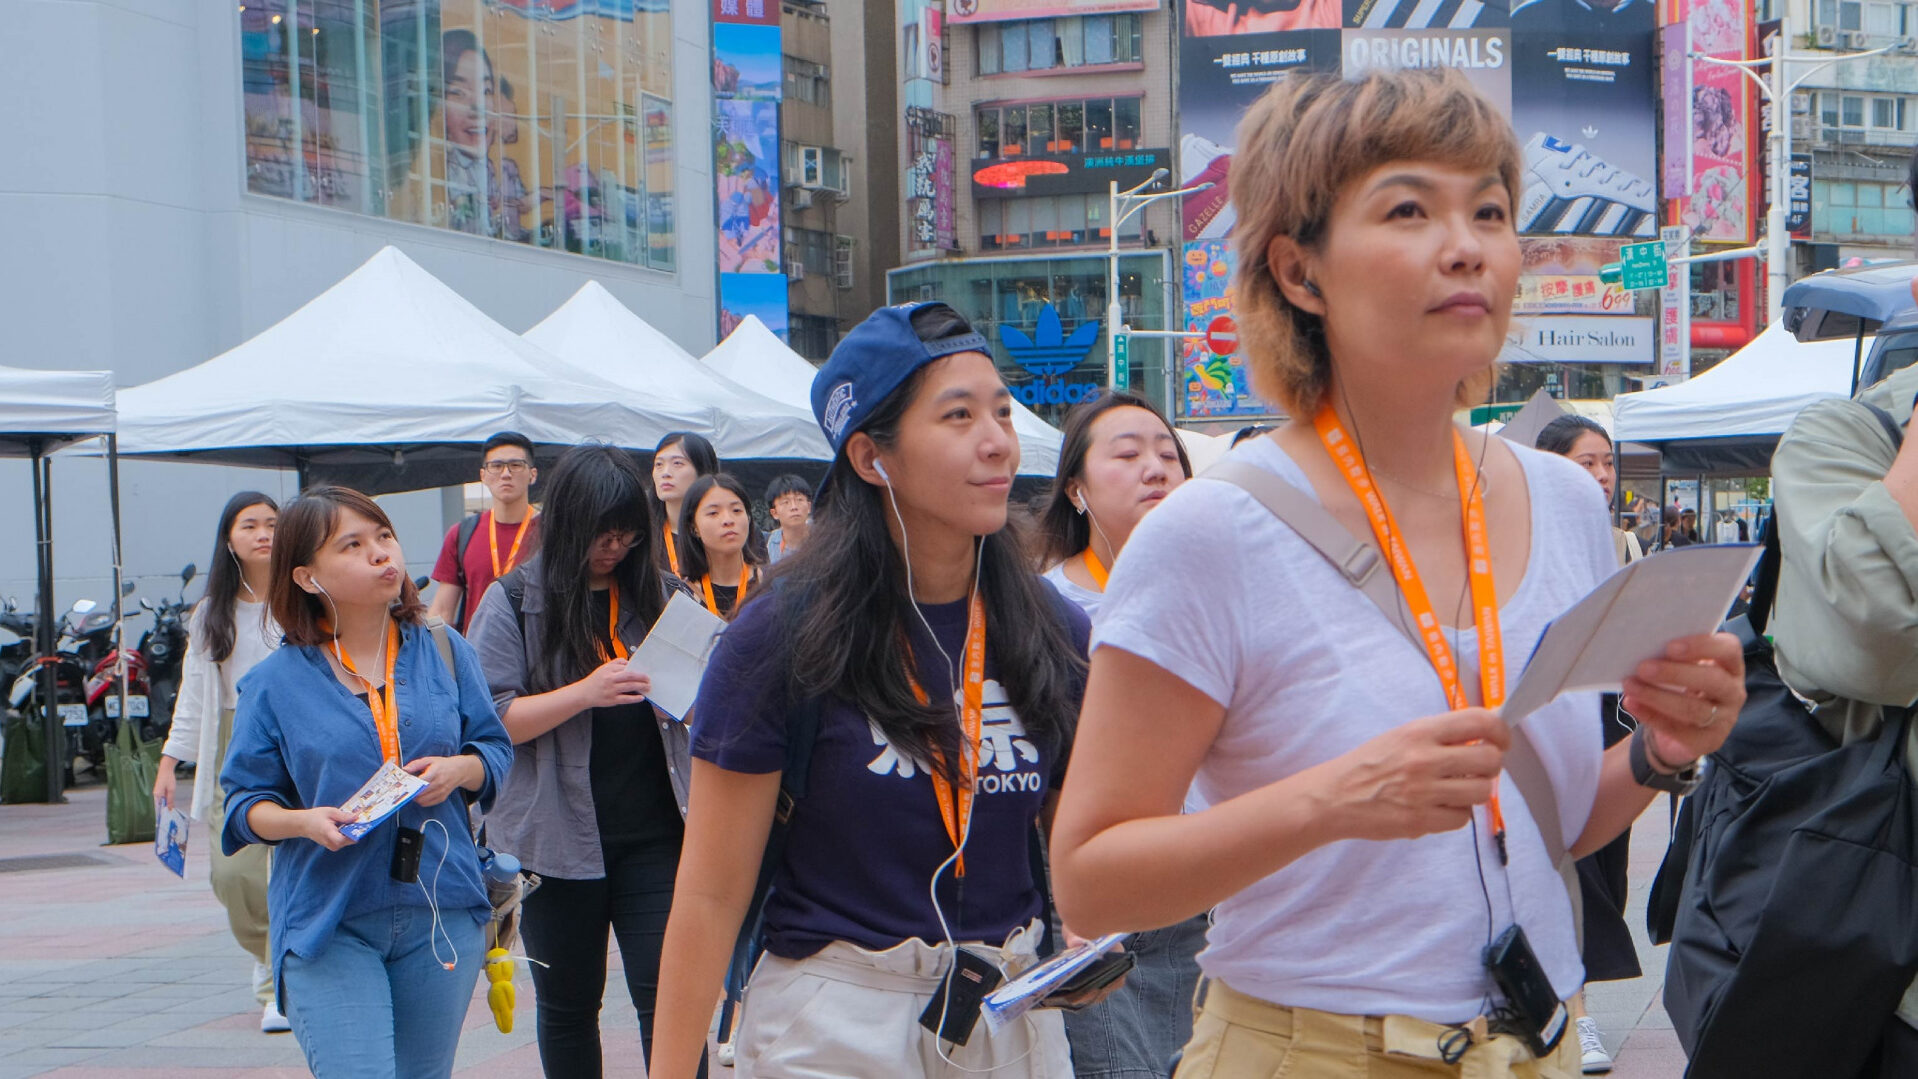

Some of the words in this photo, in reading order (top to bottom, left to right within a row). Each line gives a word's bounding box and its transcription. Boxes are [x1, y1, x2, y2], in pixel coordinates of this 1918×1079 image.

[1351, 37, 1504, 69] ORIGINALS
[1188, 195, 1223, 233] GAZELLE
[1522, 194, 1545, 223] SAMBA
[1539, 330, 1585, 346] Hair
[1587, 331, 1635, 347] Salon
[1365, 490, 1387, 523] WALK
[1381, 523, 1392, 537] in
[1391, 536, 1413, 581] TAIWAN
[1481, 606, 1496, 651] TAIWAN
[1487, 652, 1497, 664] in
[1488, 666, 1499, 700] WALK
[974, 772, 1041, 795] TOKYO
